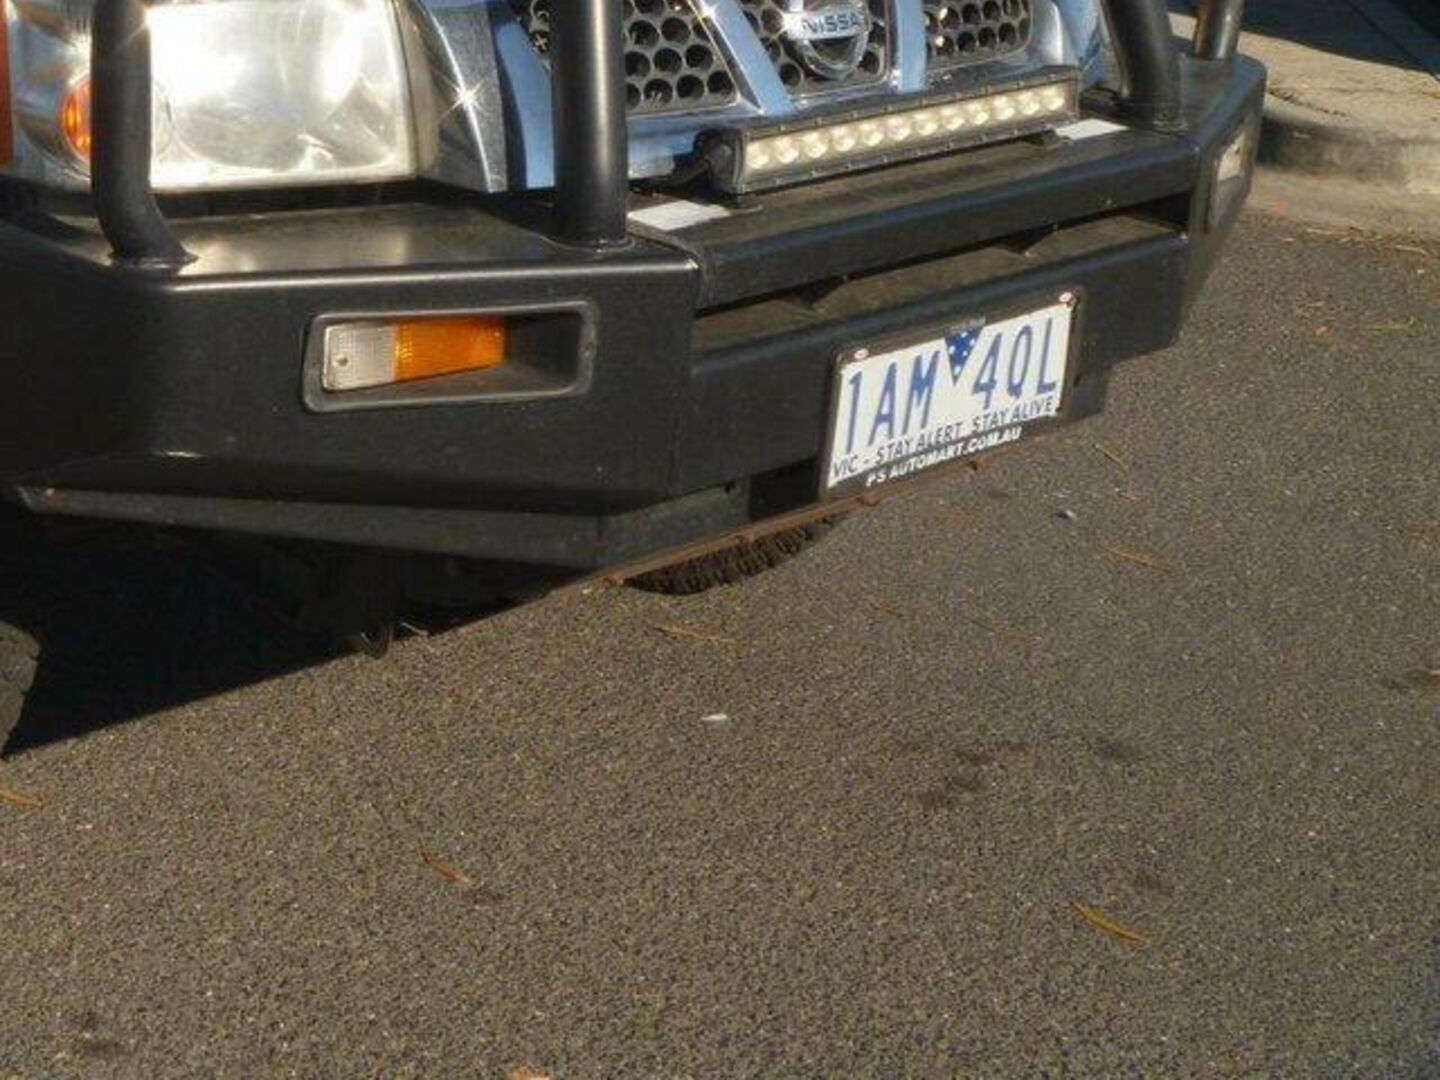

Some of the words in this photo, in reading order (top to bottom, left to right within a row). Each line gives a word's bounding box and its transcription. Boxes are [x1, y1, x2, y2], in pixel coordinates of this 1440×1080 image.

[845, 350, 941, 455] 1AM
[875, 438, 911, 465] STAY
[916, 421, 963, 451] ALERT
[972, 407, 1010, 434] STAY
[1010, 395, 1054, 423] ALIVE
